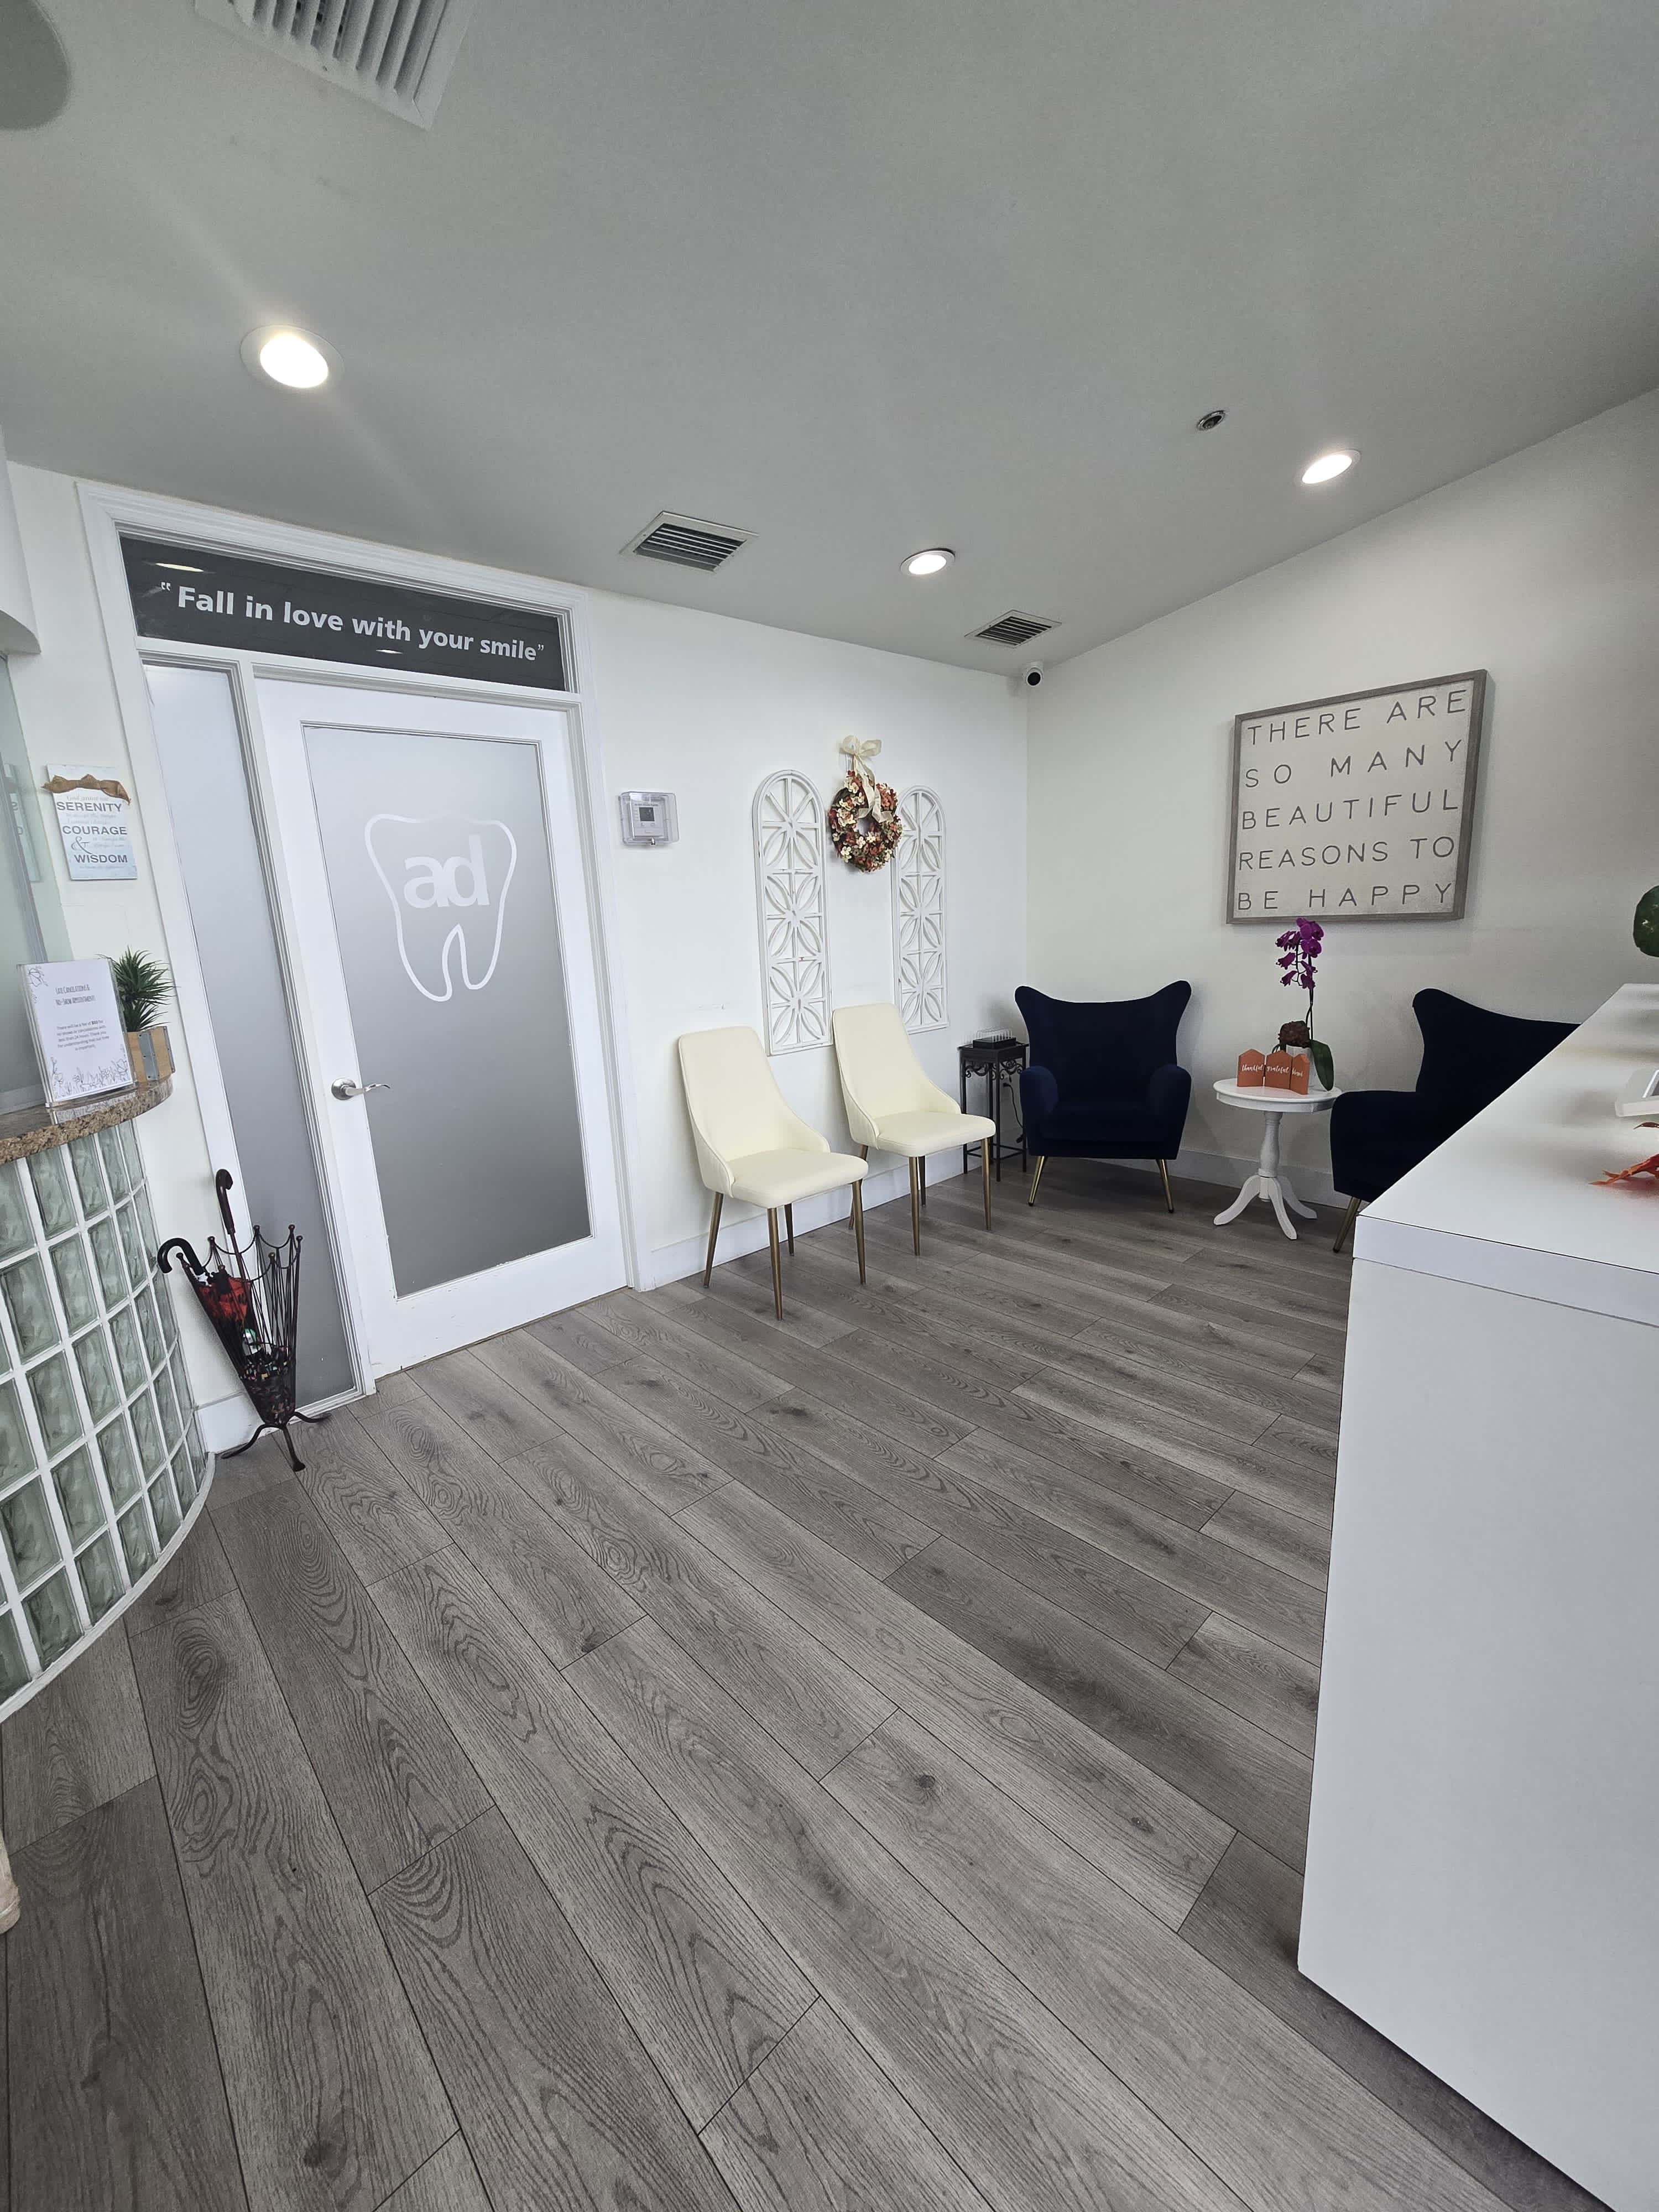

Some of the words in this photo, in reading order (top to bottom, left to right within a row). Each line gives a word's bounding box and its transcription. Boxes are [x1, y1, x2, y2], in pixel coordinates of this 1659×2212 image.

[246, 595, 273, 620] in
[284, 602, 343, 631] love
[352, 617, 411, 641] with
[419, 629, 474, 649] your
[1248, 708, 1361, 745] THERE
[1387, 690, 1467, 723] ARE
[1245, 764, 1292, 788] SO
[1331, 739, 1462, 777] MANY
[56, 802, 122, 812] SERENITY
[1242, 790, 1458, 830] BEAUTIFUL
[62, 826, 128, 834] COURAGE
[71, 836, 92, 854] &
[74, 854, 128, 863] WISDOM
[1239, 842, 1388, 870] REASONS
[1410, 836, 1454, 859] TO
[404, 834, 490, 908] ad
[1238, 891, 1279, 910] BE
[1309, 883, 1452, 907] HAPPY
